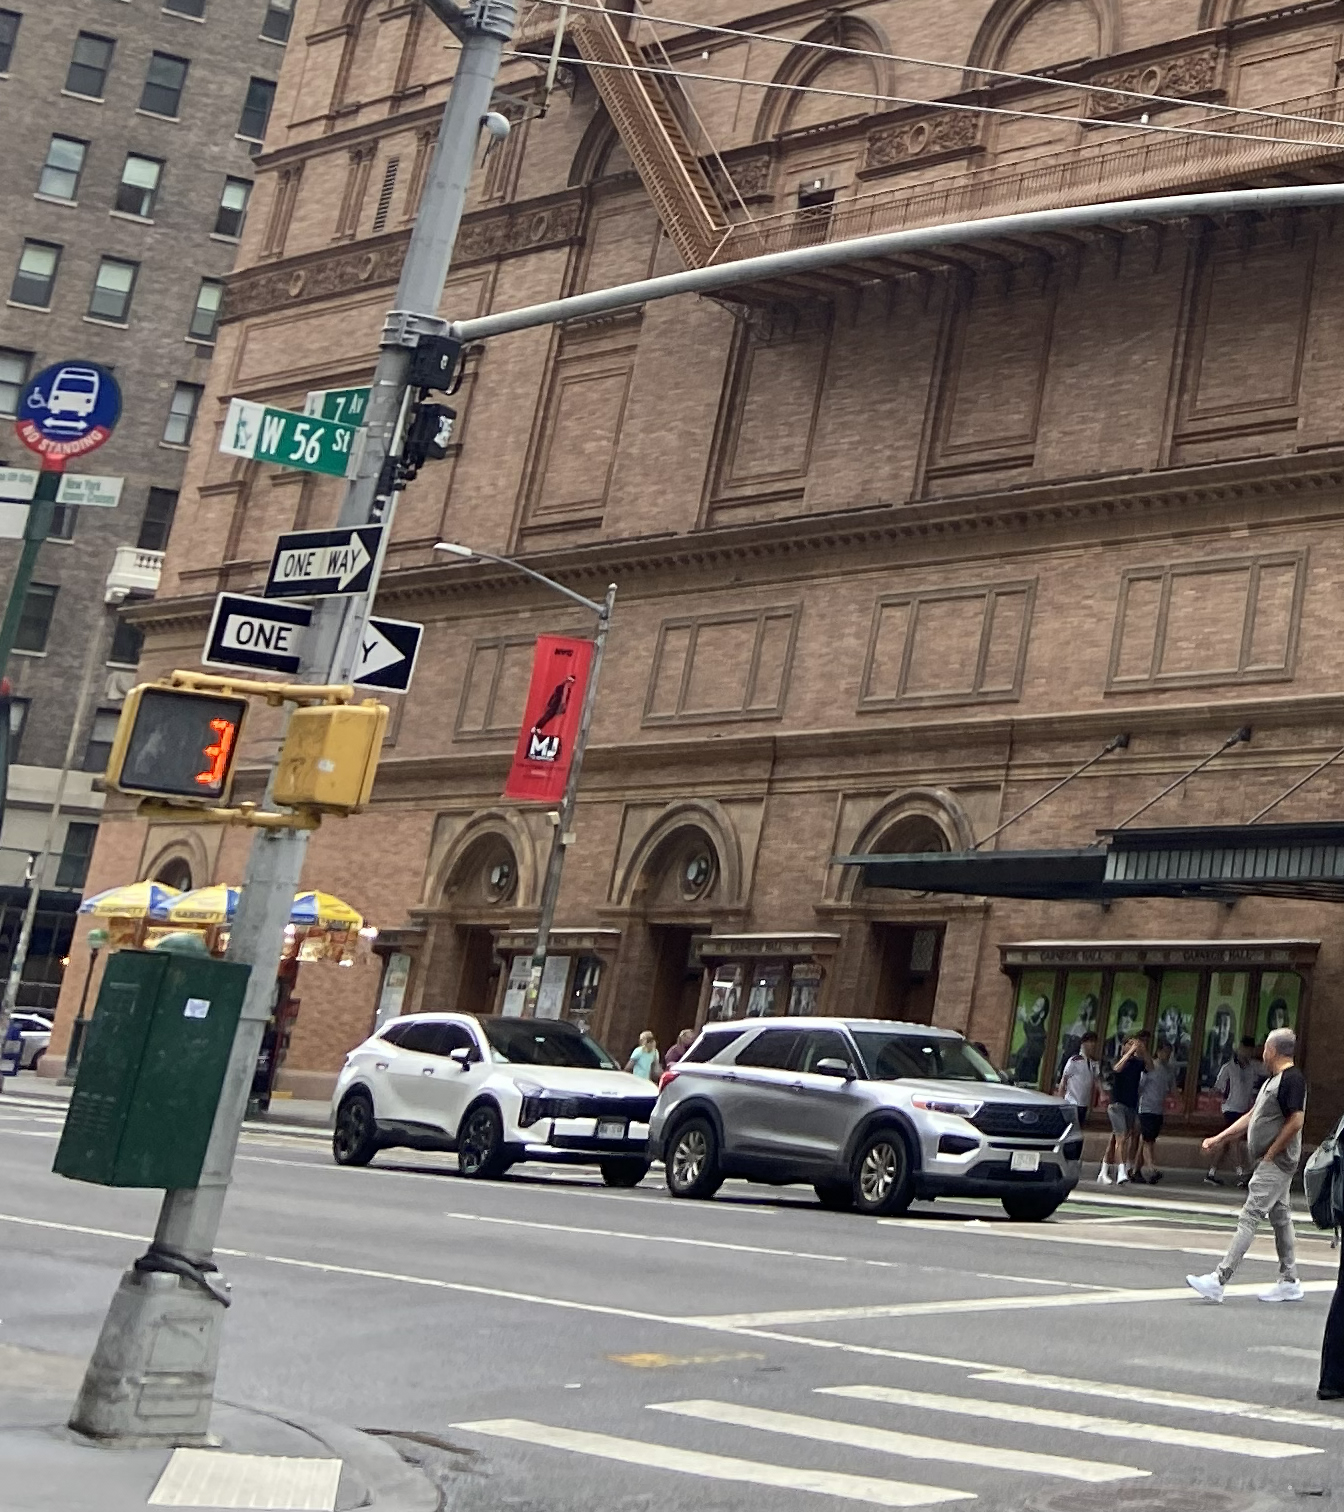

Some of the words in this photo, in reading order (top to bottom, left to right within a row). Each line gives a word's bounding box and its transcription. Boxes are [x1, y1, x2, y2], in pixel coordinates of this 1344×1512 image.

[333, 396, 346, 423] 7
[348, 392, 364, 415] Av
[21, 424, 41, 443] NO
[37, 428, 104, 455] STANDING
[260, 414, 287, 455] W
[288, 421, 325, 464] 56
[332, 428, 351, 453] St
[283, 552, 316, 578] ONE
[326, 547, 363, 576] WAY
[235, 620, 293, 652] ONE
[529, 734, 560, 758] MJ
